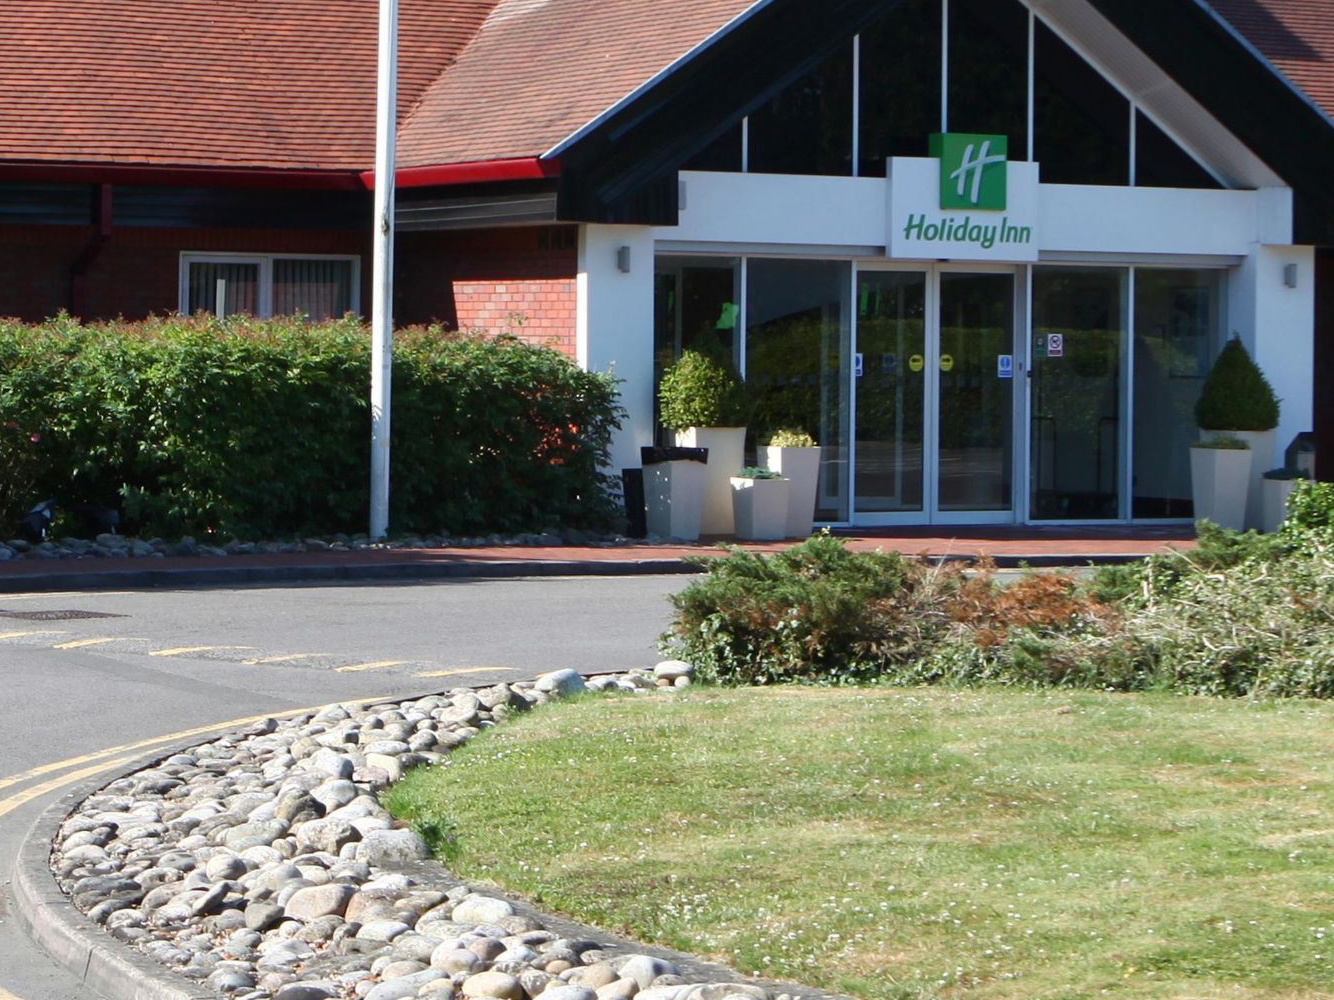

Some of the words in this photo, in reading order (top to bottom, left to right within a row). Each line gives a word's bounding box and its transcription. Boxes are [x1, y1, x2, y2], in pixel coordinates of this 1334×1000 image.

[950, 140, 1005, 203] H
[903, 214, 997, 249] Holiday
[1000, 216, 1031, 243] Inn
